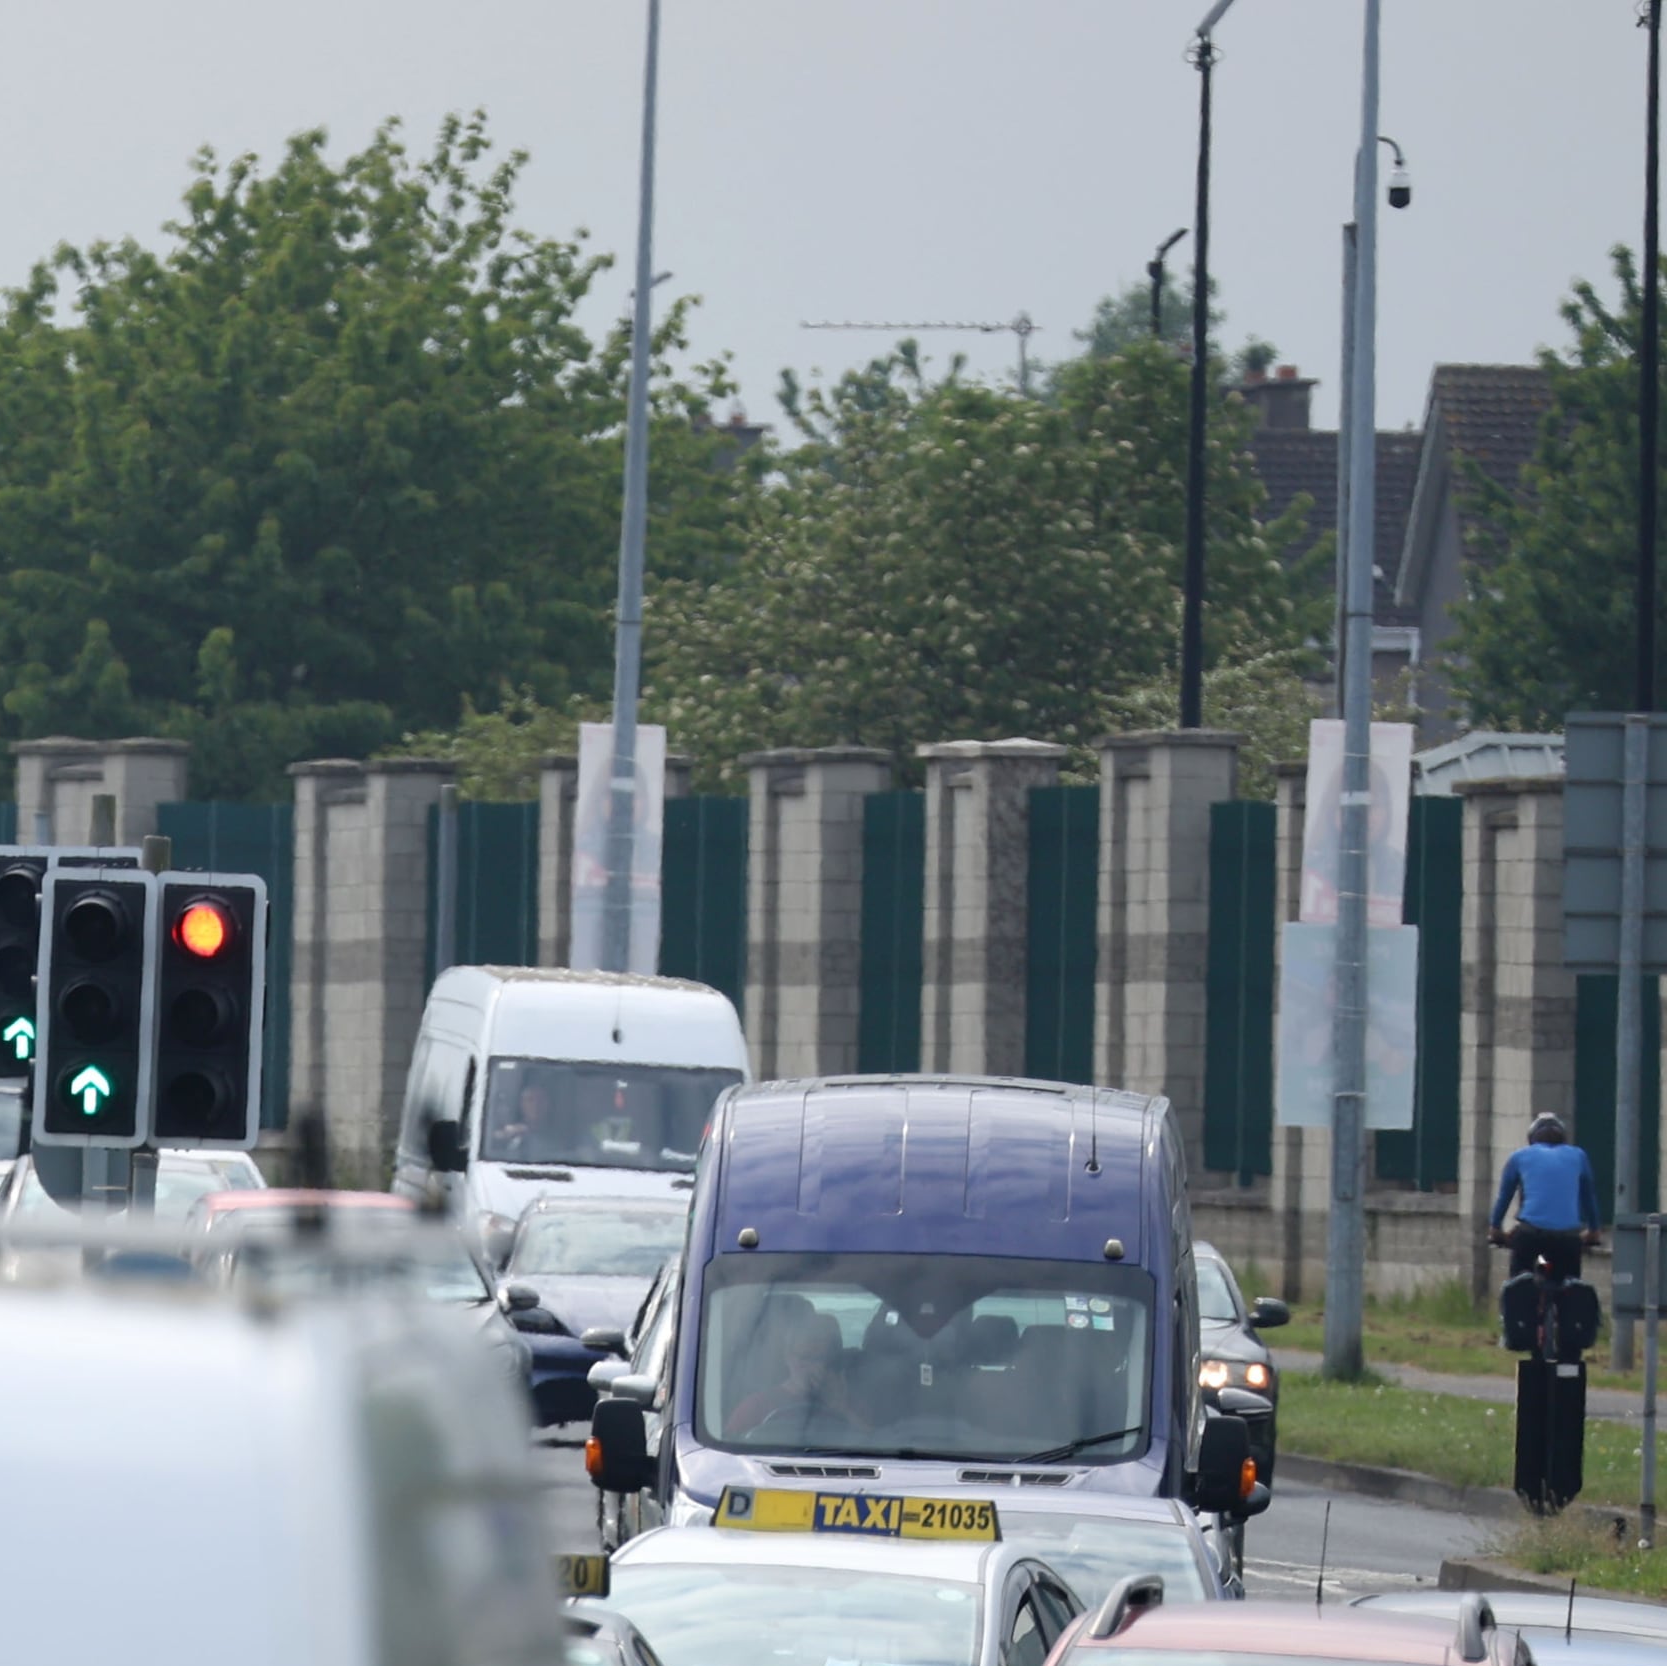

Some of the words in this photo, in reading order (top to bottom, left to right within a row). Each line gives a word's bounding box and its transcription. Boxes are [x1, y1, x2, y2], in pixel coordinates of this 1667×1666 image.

[727, 1490, 751, 1516] D
[818, 1496, 901, 1531] TAXI
[921, 1502, 991, 1531] 21035
